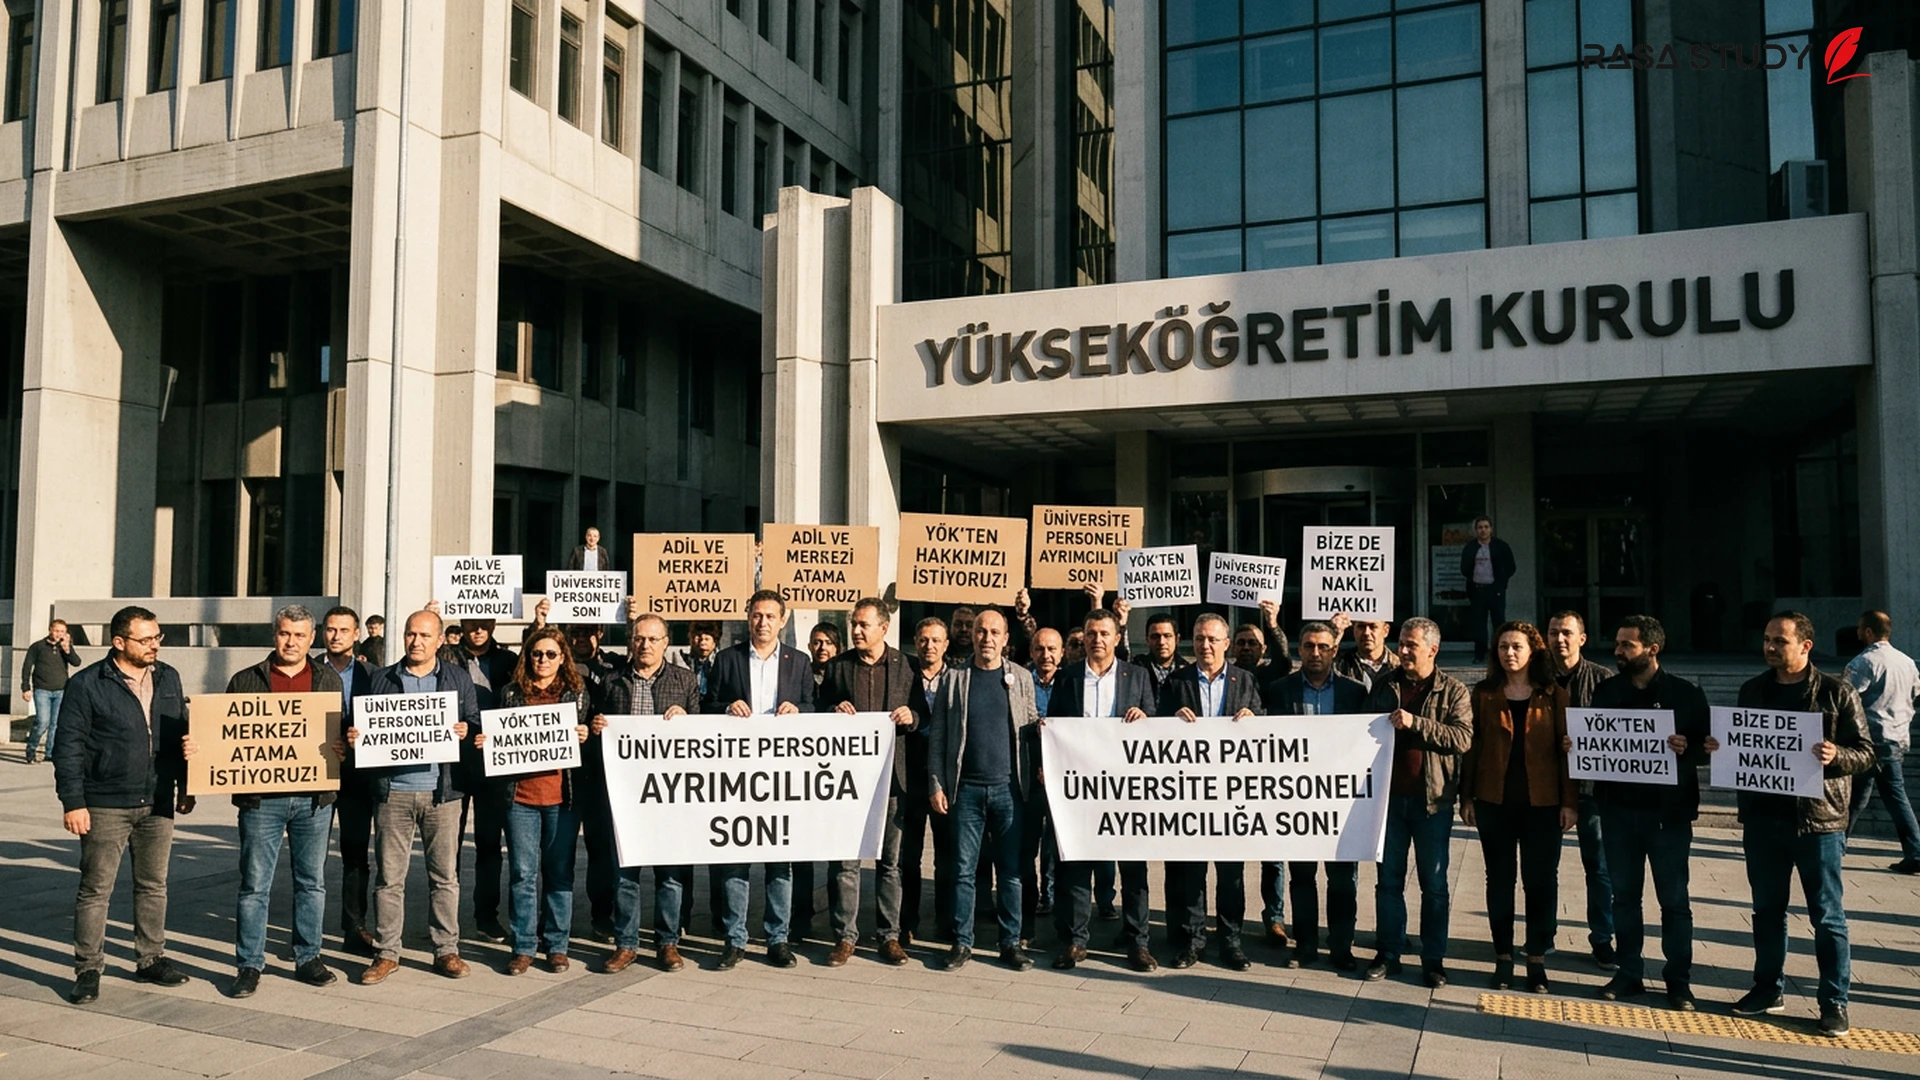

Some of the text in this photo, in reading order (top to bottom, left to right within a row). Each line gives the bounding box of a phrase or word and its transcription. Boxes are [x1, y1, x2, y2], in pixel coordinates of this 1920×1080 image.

[921, 268, 1797, 387] YÜKSEKÖĞRETİM KURULU
[1044, 509, 1130, 528] ÜNİVERSİTE
[831, 532, 849, 545] VE
[925, 522, 998, 544] YÖK'TEN
[1317, 531, 1380, 550] BİZE DE
[663, 536, 724, 554] ADİL VE
[454, 557, 501, 570] ADİL VE
[658, 556, 728, 574] MERKEZİ
[787, 548, 854, 565] MERKEZİ
[916, 547, 1006, 567] HAKKIMIZI
[1311, 554, 1385, 571] MERKEZİ
[793, 569, 846, 583] ATAMA
[913, 565, 1008, 588] İSTİYORUZ!
[1068, 568, 1103, 582] SON!
[1322, 574, 1374, 591] NAKİL
[457, 588, 499, 599] ATAMA
[665, 580, 721, 593] ATAMA
[572, 606, 601, 617] SON!
[1318, 596, 1377, 613] HAKKI!
[227, 696, 303, 717] ADİL VE
[365, 695, 447, 713] ÜNİVERSİTE
[221, 718, 307, 740] MERKEZİ
[1584, 713, 1656, 733] YÖK'TEN
[1732, 709, 1797, 731] BİZE DE
[618, 730, 880, 759] ÜNİVERSİTE PERSONELİ
[1122, 738, 1211, 764] VAKAR
[1577, 736, 1665, 754] HAKKIMIZI
[1727, 731, 1802, 752] MERKEZİ
[231, 745, 297, 762] ATAMA
[391, 748, 424, 761] SON!
[1739, 752, 1791, 771] NAKİL
[209, 765, 317, 786] İSTİYORUZ!
[640, 763, 858, 804] AYRIMCILIĞA
[1063, 767, 1373, 801] ÜNİVERSİTE PERSONELİ
[1735, 771, 1795, 792] HAKKI!
[1097, 805, 1340, 836] AYRIMCILIĞA SON!
[709, 815, 790, 848] SON!
